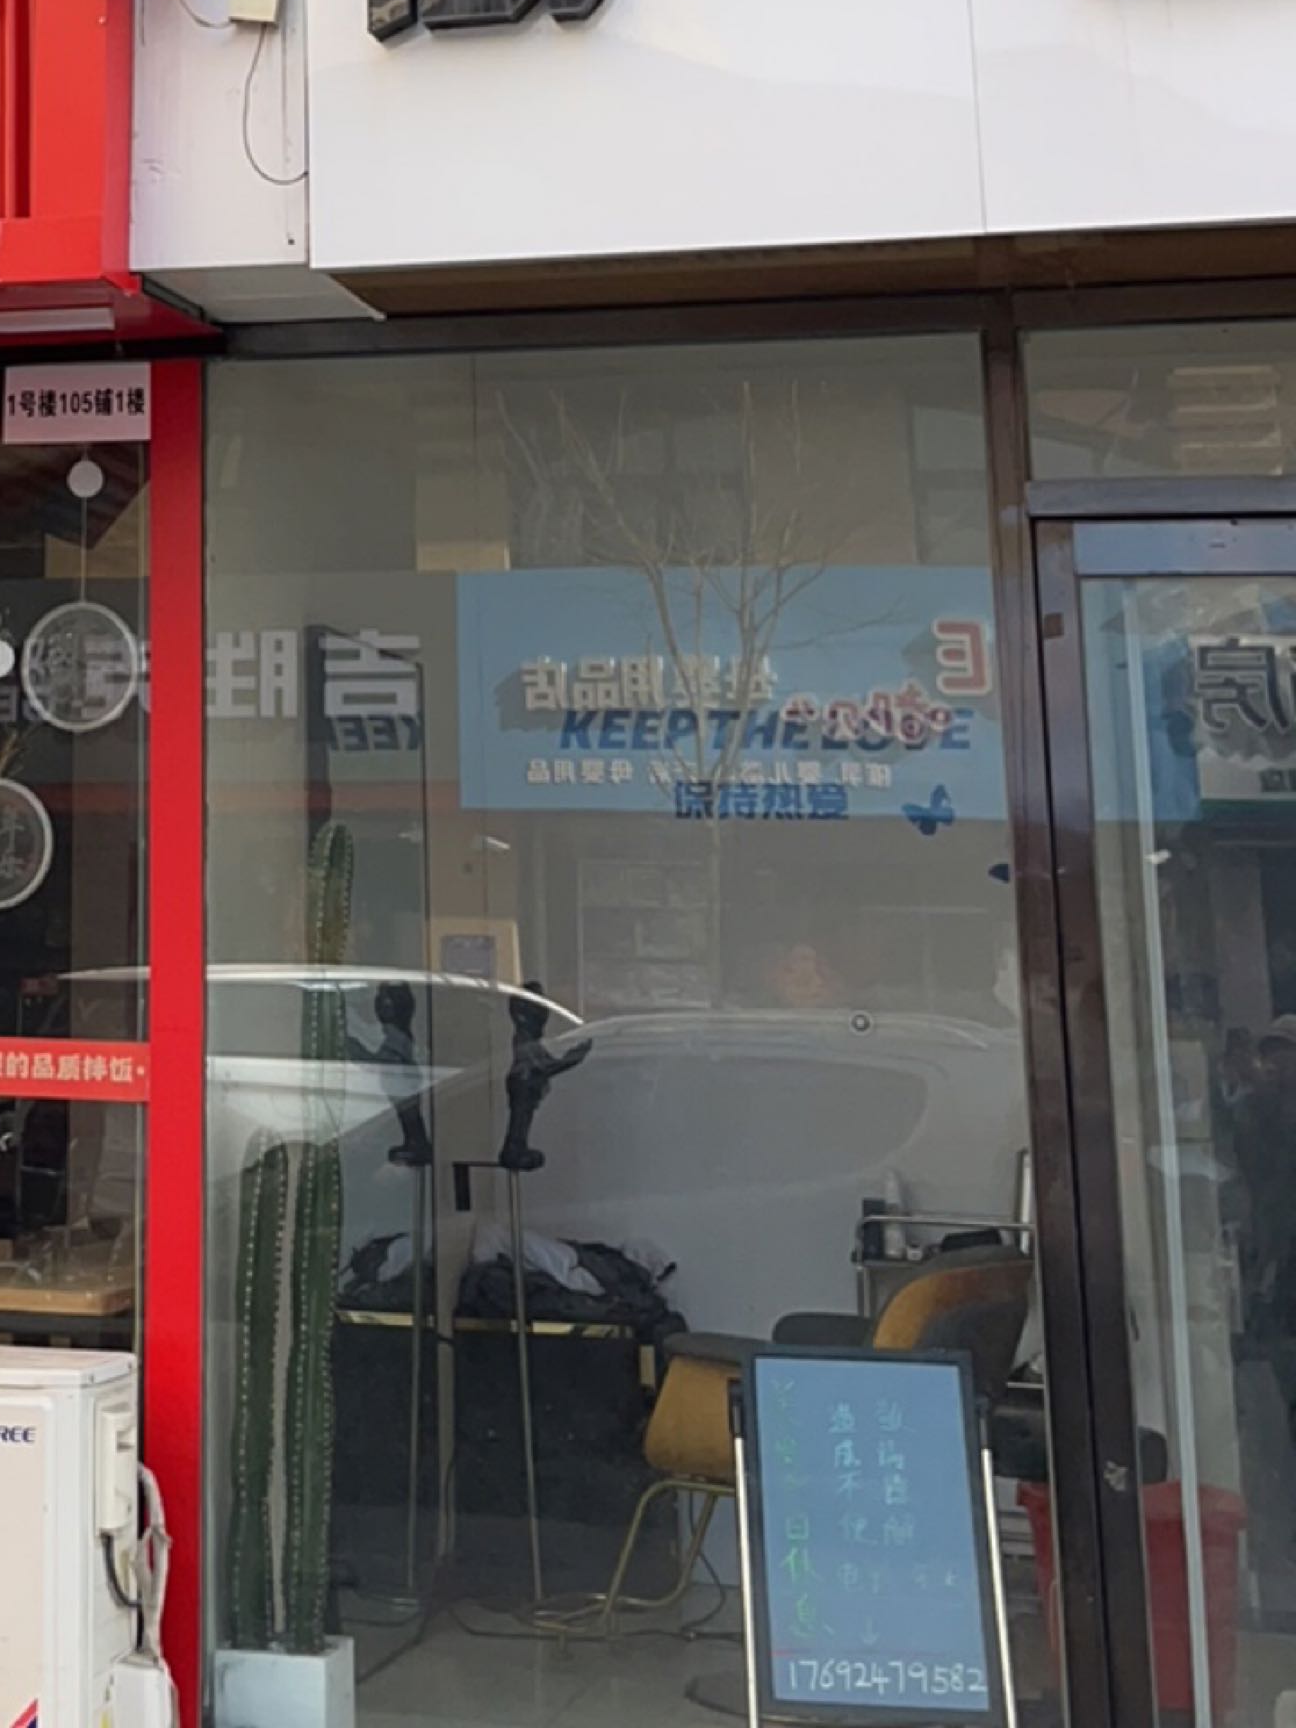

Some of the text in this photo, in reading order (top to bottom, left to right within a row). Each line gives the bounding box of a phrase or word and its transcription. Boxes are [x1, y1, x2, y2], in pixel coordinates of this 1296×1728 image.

[7, 386, 146, 419] 1号楼105铺1楼
[789, 1659, 987, 1696] 17692479582
